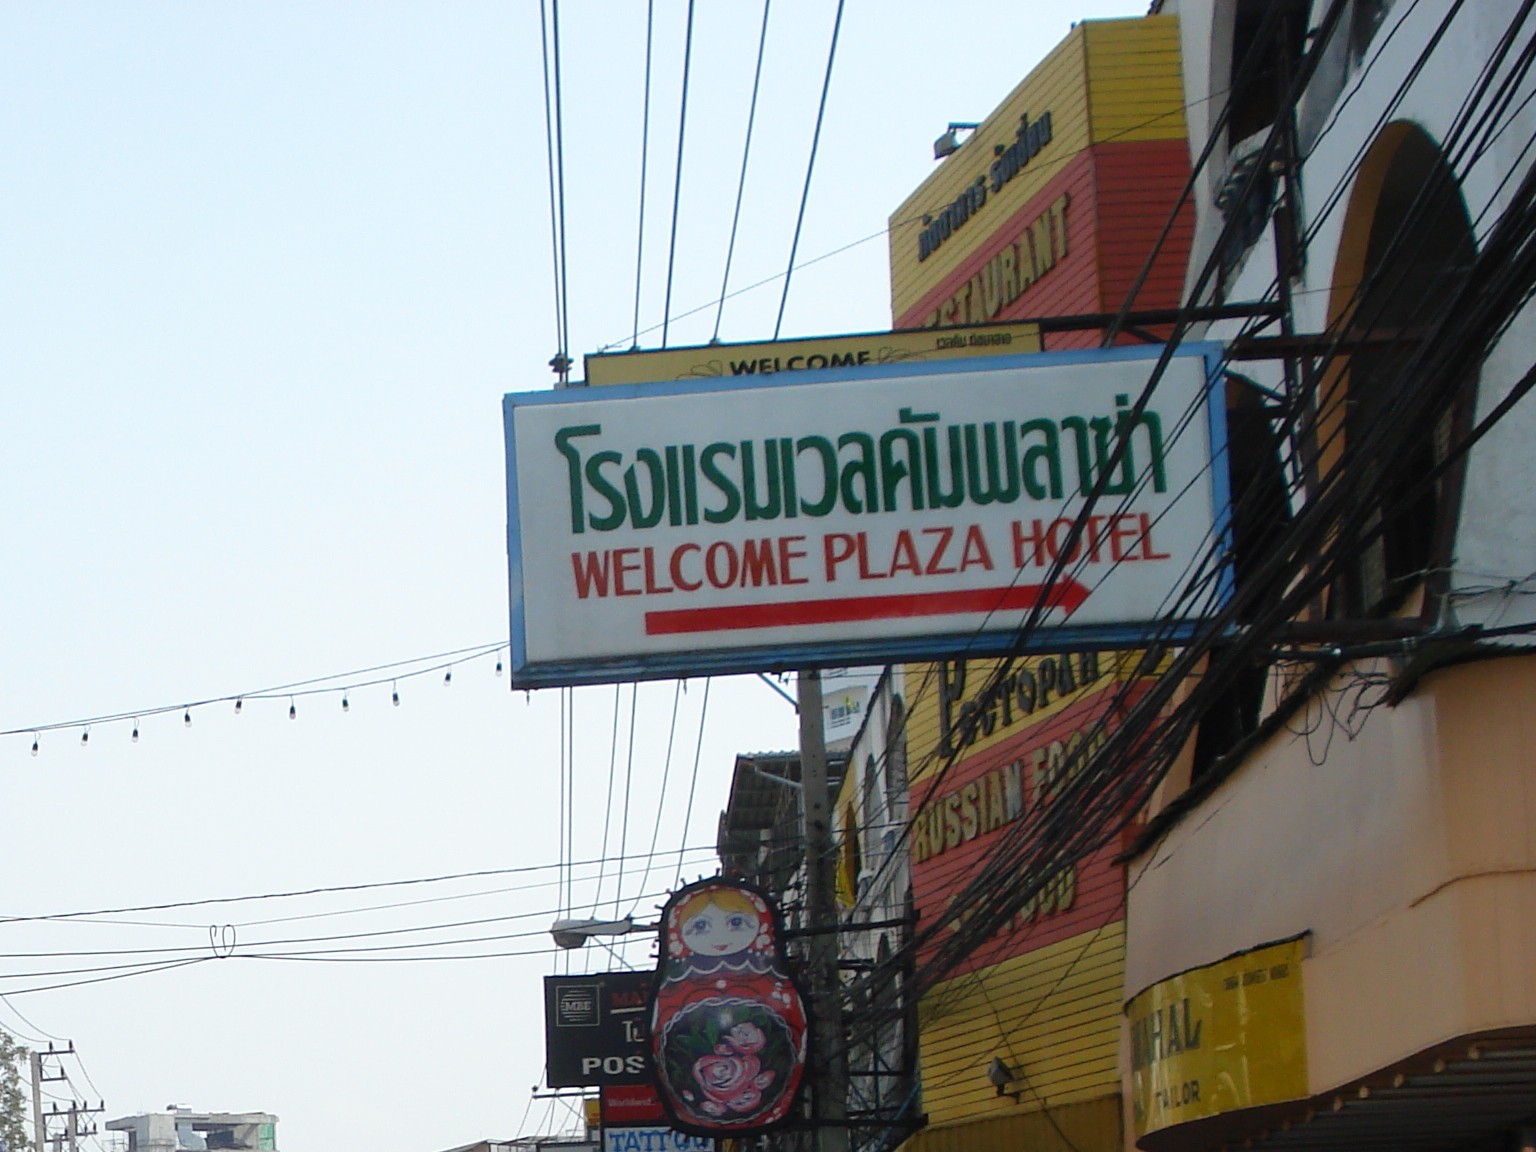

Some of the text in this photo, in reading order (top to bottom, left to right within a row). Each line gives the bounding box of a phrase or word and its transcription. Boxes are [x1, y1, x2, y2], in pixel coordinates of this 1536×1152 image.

[729, 350, 871, 377] WELCOME
[570, 511, 1172, 600] WELCOME PLAZA HOTEL
[916, 757, 1026, 864] RUSSIAN
